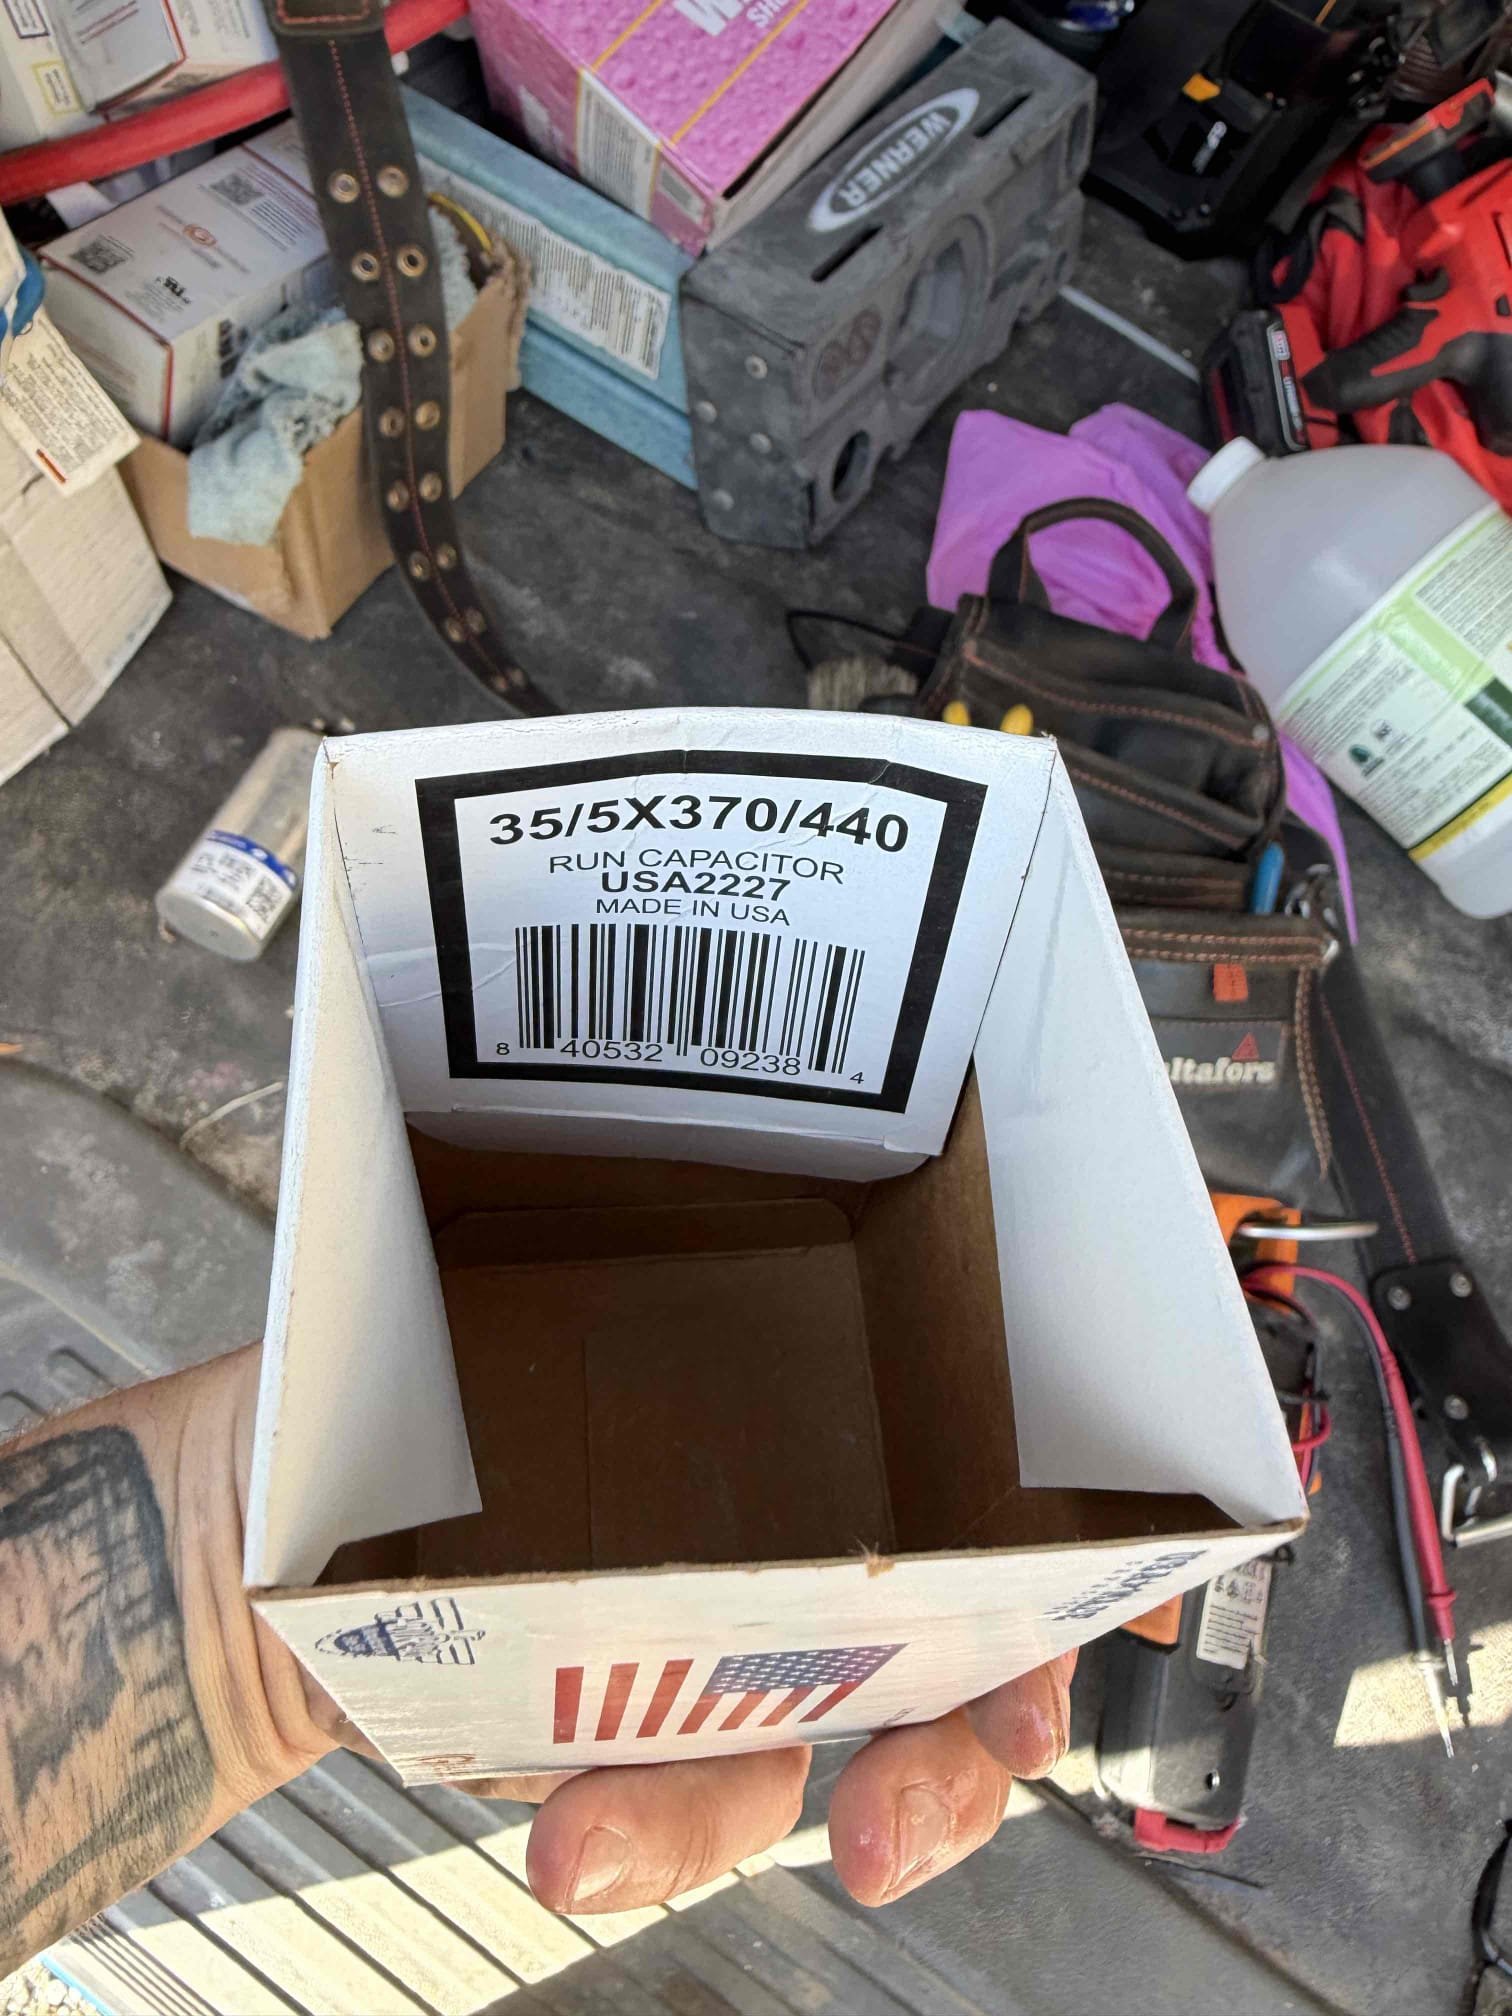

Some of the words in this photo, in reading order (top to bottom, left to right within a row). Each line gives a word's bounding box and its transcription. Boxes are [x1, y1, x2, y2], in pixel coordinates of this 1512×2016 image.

[838, 111, 951, 207] WERNER
[489, 794, 909, 852] 35/5X370/440
[549, 850, 624, 874] RUN
[638, 848, 844, 884] CAPACITOR
[601, 870, 791, 902] USA2227
[595, 898, 681, 916] MADE
[692, 899, 721, 916] IN
[730, 901, 790, 926] USA
[495, 1042, 510, 1056] 8
[560, 1039, 663, 1063] 40532
[700, 1048, 801, 1076] 09238
[849, 1071, 864, 1084] 4
[1165, 1056, 1276, 1085] ltafors
